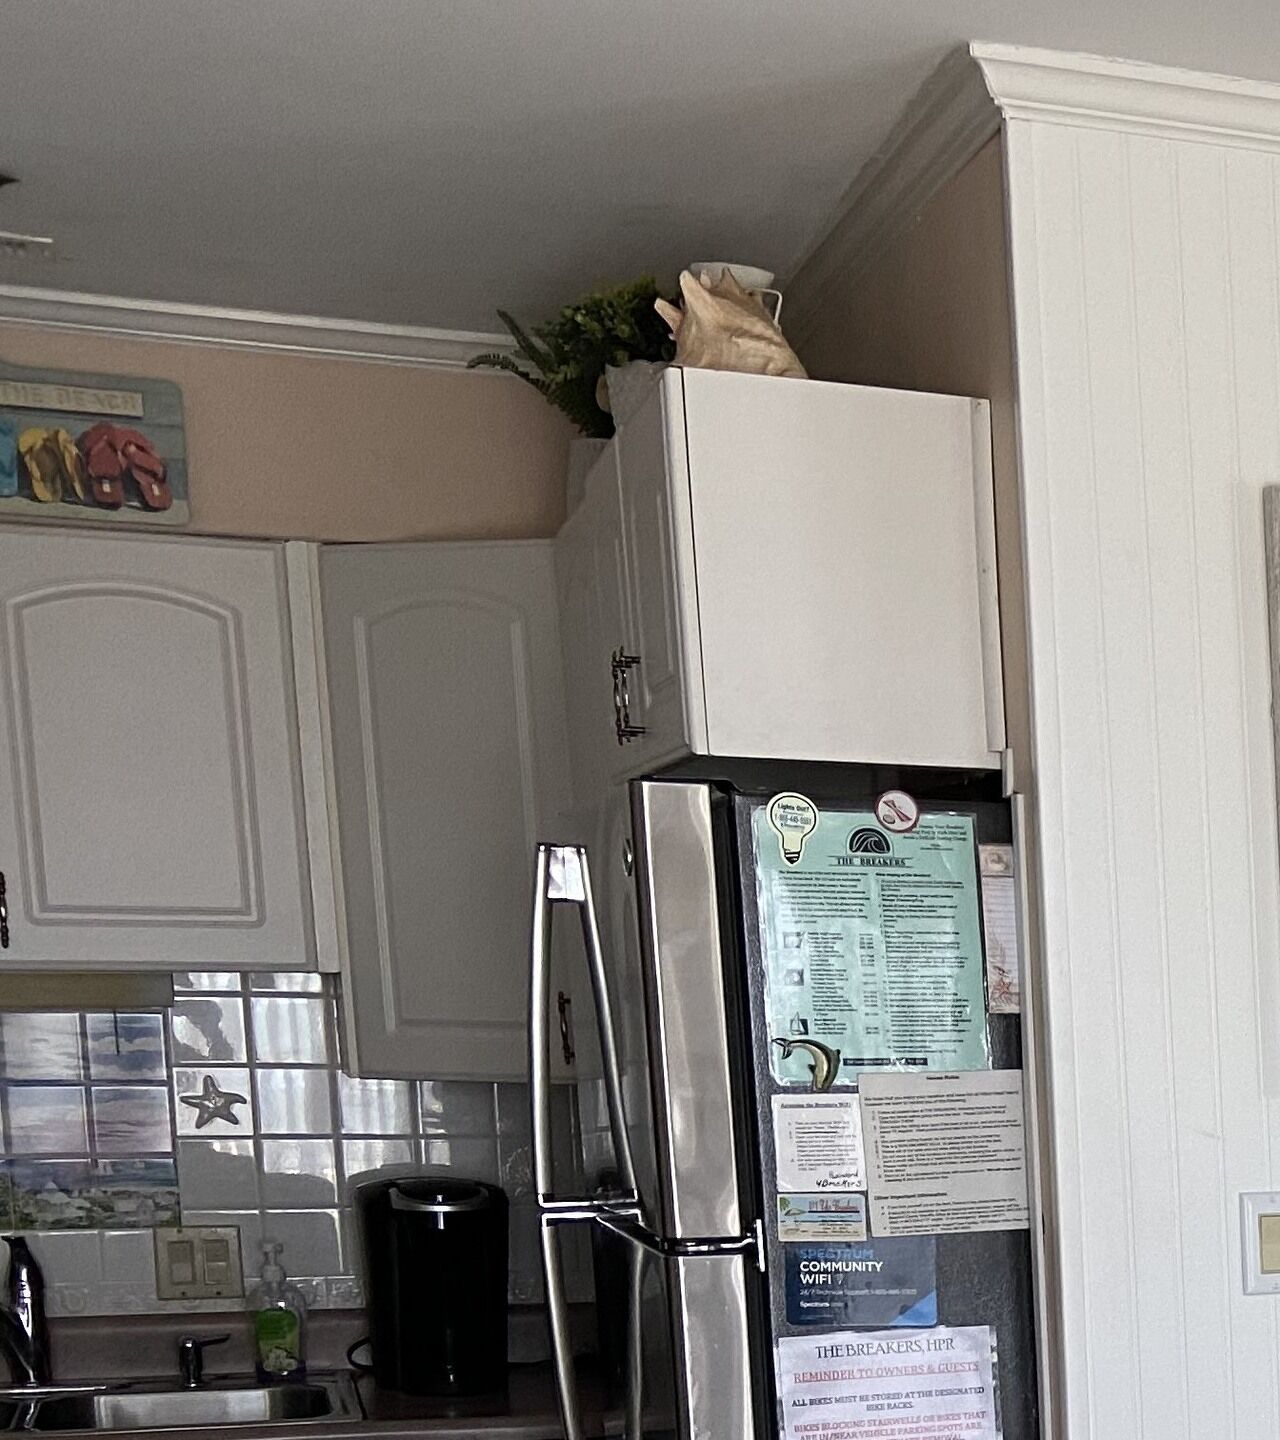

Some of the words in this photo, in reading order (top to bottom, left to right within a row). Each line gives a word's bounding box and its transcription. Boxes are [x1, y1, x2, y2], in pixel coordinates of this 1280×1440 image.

[860, 858, 906, 866] BREAKERS
[800, 1249, 874, 1259] SPECTRUM
[800, 1261, 883, 1272] COMMUNITY
[800, 1274, 832, 1285] WIFI
[815, 1345, 844, 1359] THE
[846, 1340, 925, 1357] BREAKERS,
[926, 1338, 955, 1352] HPR
[794, 1368, 855, 1384] REMINDER
[857, 1368, 873, 1378] TO
[876, 1364, 925, 1377] OWNERS
[927, 1364, 936, 1374] &
[938, 1361, 980, 1373] GUESTS
[792, 1399, 808, 1407] ALL
[809, 1397, 834, 1406] BIKES
[834, 1396, 858, 1404] MUST
[871, 1393, 903, 1401] STORED
[904, 1391, 915, 1399] AT
[915, 1390, 933, 1398] THE
[935, 1387, 985, 1397] DESIGNATED
[866, 1403, 886, 1412] BIKE
[794, 1424, 819, 1433] BIKES
[821, 1420, 865, 1431] BLOCKING
[867, 1416, 921, 1427] STAIRWELLS
[963, 1411, 986, 1420] THAT
